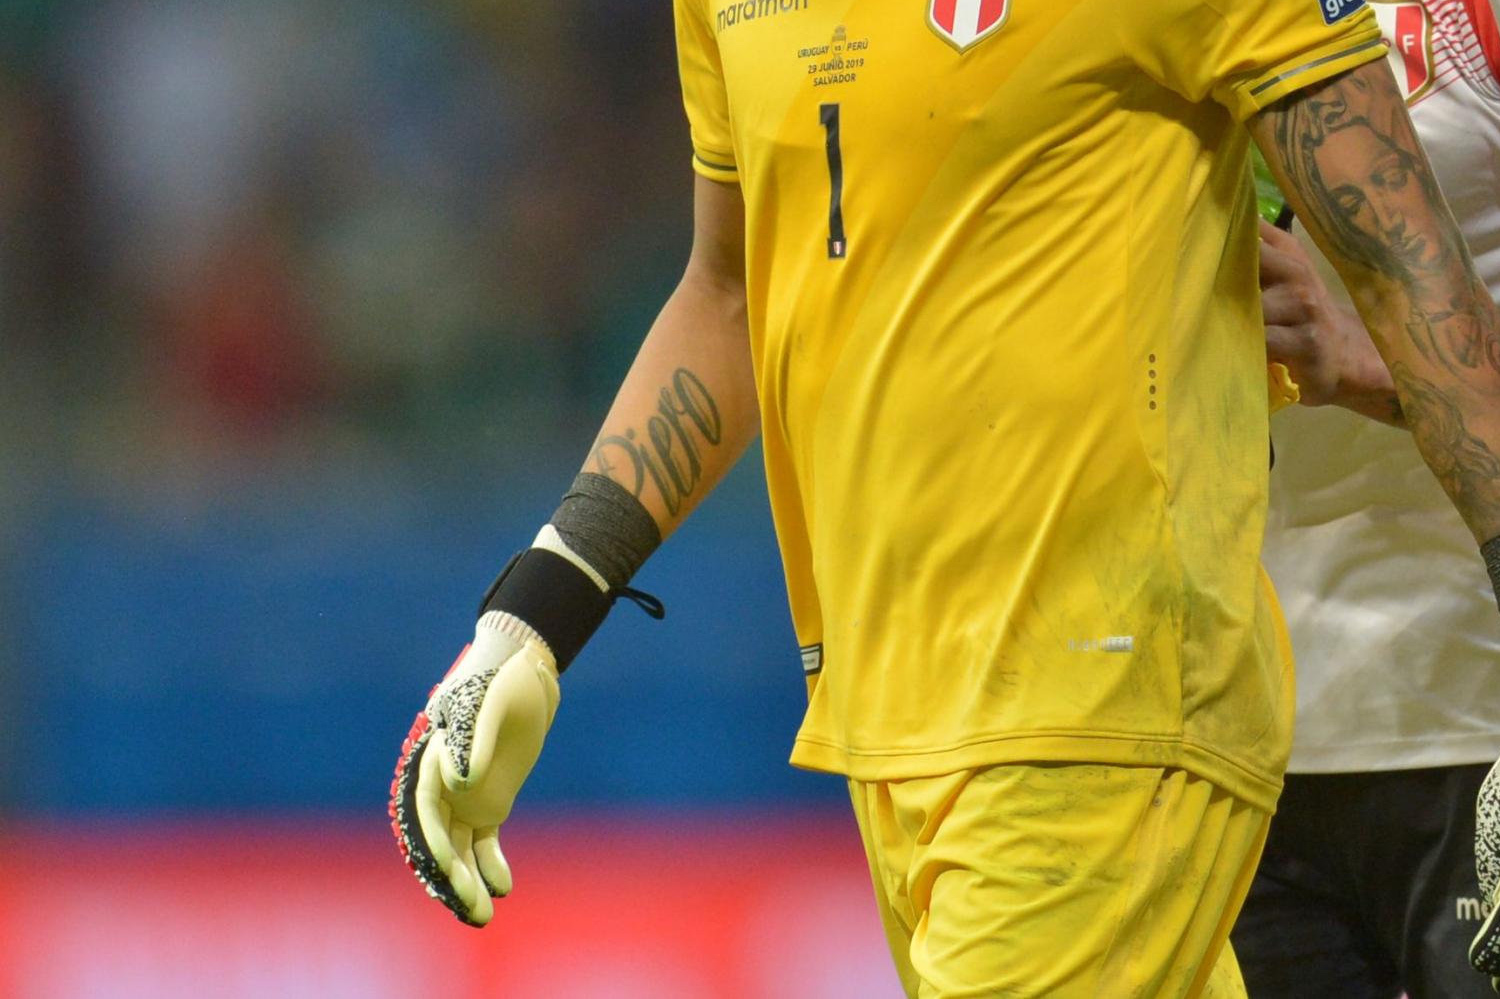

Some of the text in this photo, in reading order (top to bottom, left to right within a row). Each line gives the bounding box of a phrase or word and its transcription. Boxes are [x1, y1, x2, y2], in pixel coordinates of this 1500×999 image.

[797, 44, 830, 58] URUGUAY
[808, 58, 864, 75] 29 JUNIO 2019
[813, 73, 857, 87] SALVADOR
[820, 103, 847, 260] 1
